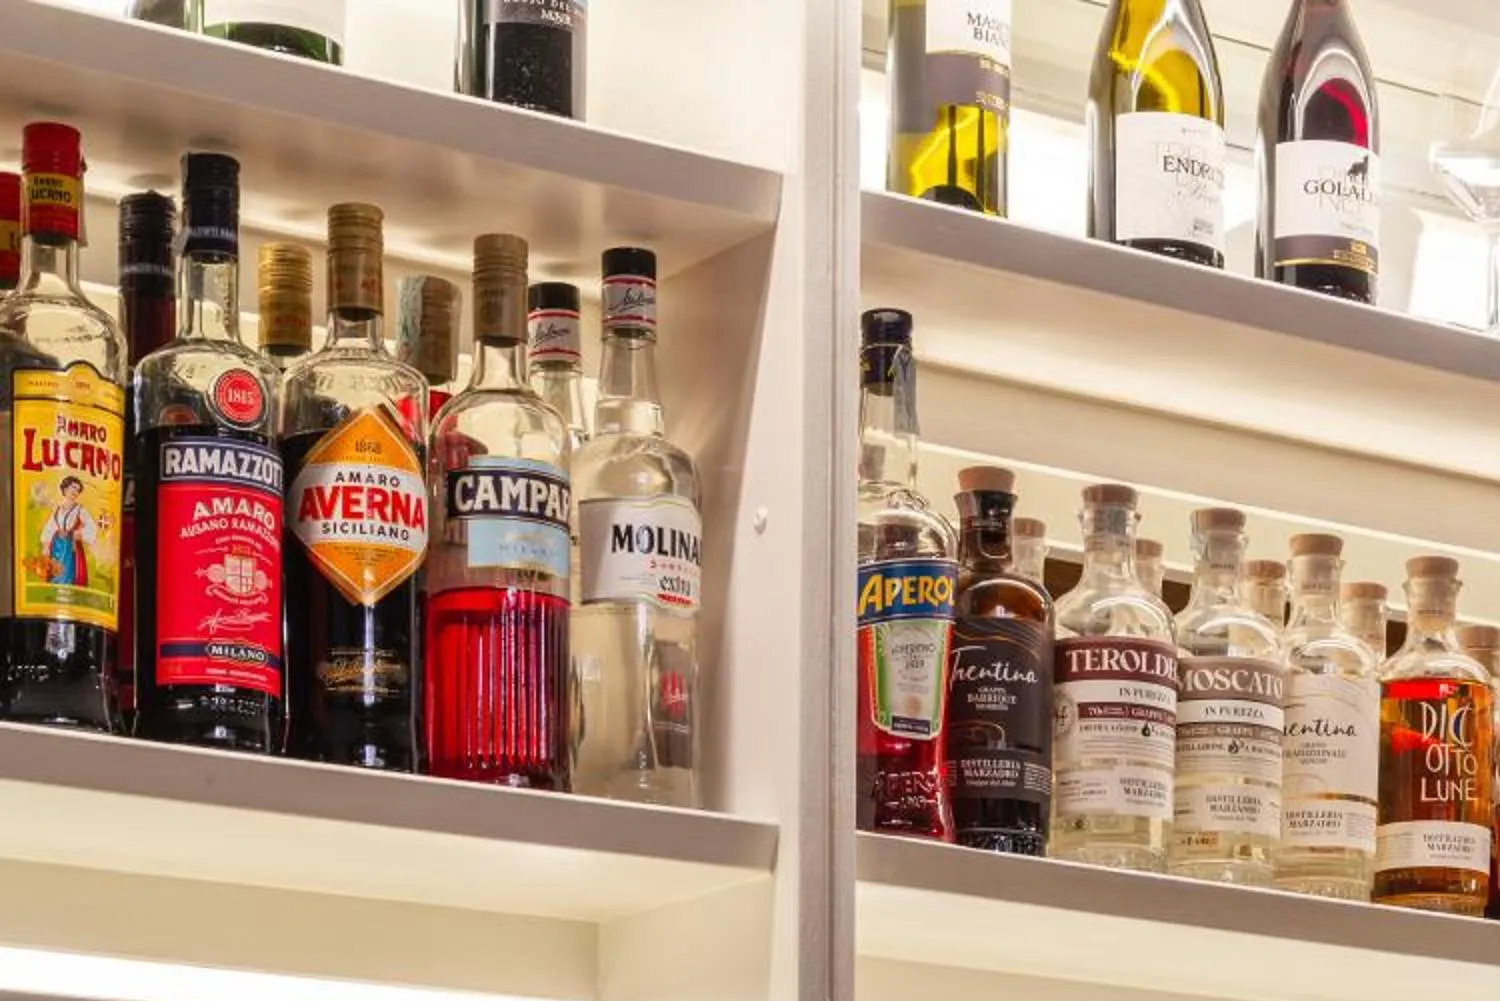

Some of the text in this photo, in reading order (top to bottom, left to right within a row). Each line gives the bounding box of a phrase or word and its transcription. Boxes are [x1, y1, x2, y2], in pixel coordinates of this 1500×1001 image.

[57, 415, 107, 442] AMARO
[22, 427, 121, 481] LUCANO
[335, 471, 401, 488] AMARO
[192, 497, 276, 531] AMARO
[297, 484, 425, 533] AVERNA
[321, 521, 410, 541] SICILIANO
[210, 644, 266, 662] MILANO
[1425, 743, 1478, 776] OTTO
[1420, 776, 1479, 802] LUNE
